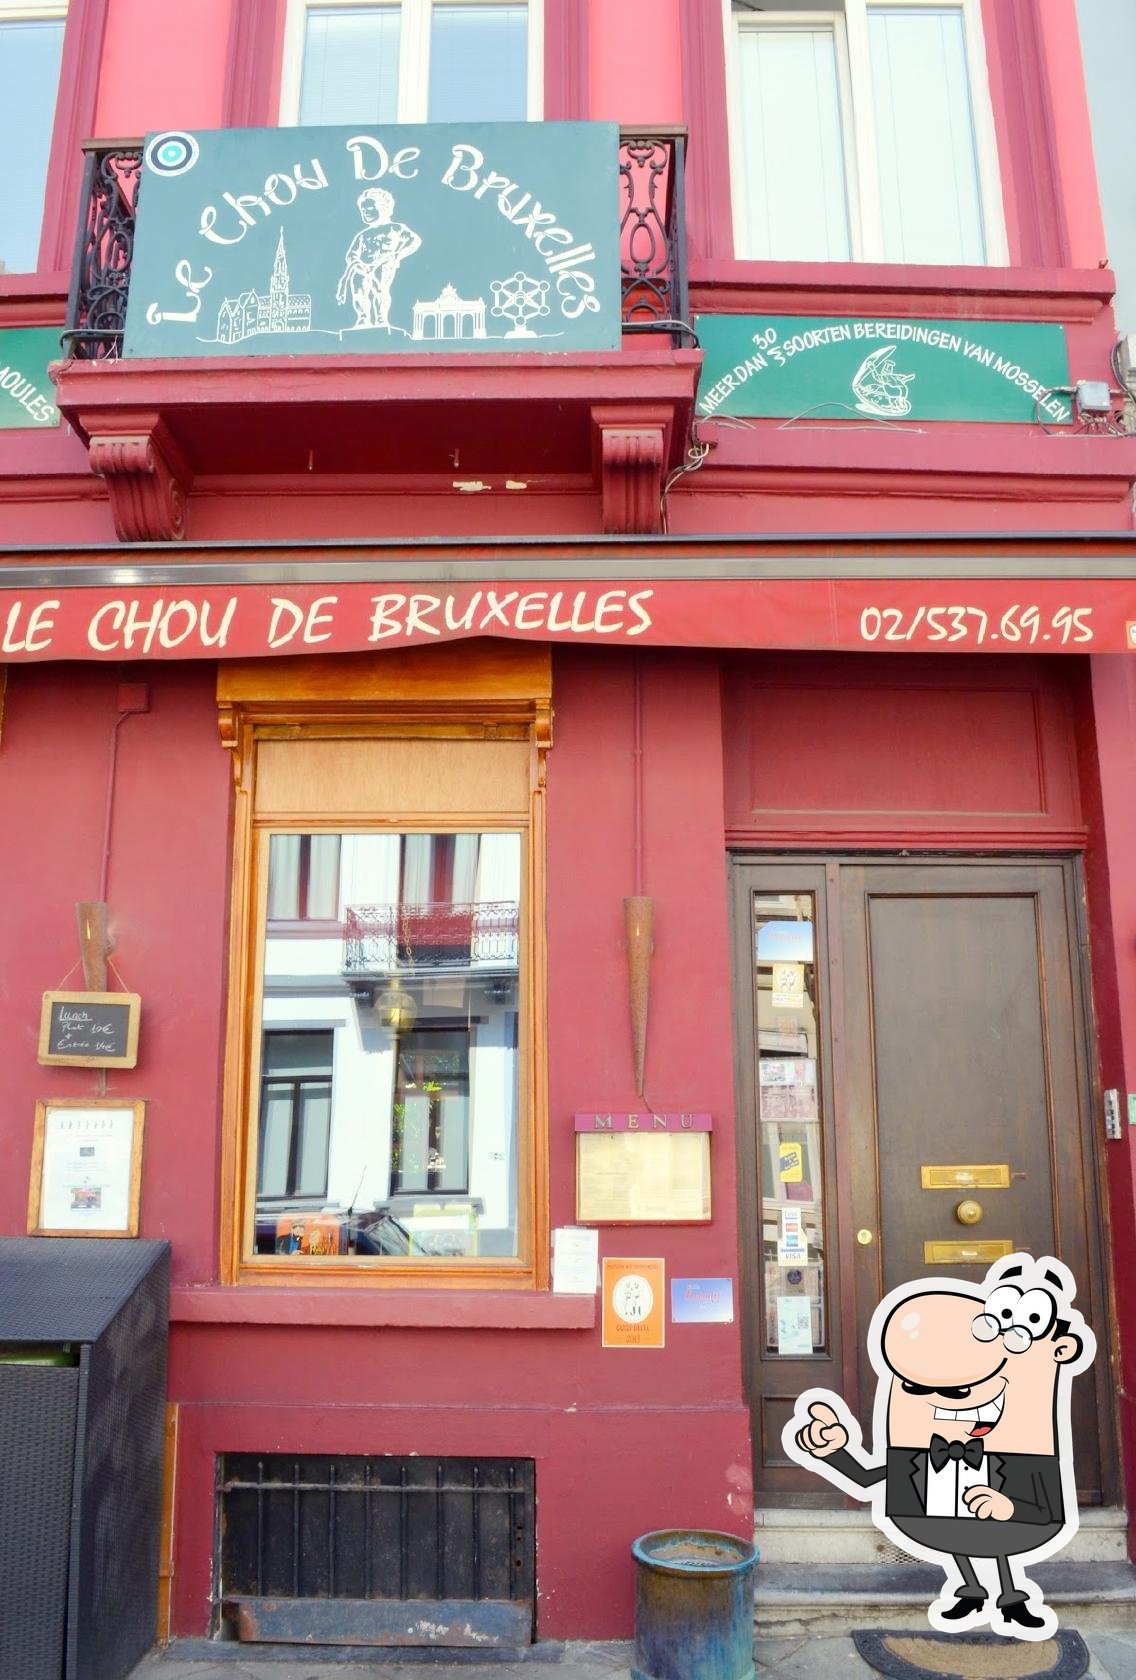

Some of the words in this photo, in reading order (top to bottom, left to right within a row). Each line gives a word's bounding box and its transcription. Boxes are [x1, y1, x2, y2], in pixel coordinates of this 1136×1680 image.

[146, 260, 212, 326] Le
[199, 159, 328, 245] Chou
[346, 136, 421, 181] De
[441, 144, 601, 319] Bruxelles
[699, 374, 741, 414] MEER
[733, 353, 769, 382] DAN
[752, 328, 777, 350] 30
[783, 324, 852, 357] SOORTEN
[853, 322, 962, 353] BEREIDINGEN
[963, 341, 996, 367] VAN
[992, 356, 1070, 422] MOSSELEN
[2, 599, 60, 653] LE
[88, 597, 238, 654] CHOU
[268, 596, 339, 649] DE
[368, 590, 654, 642] BRUXELLES
[861, 605, 1094, 645] 02/537.69.95
[58, 1006, 91, 1021] Lunch
[595, 1114, 694, 1131] MENU
